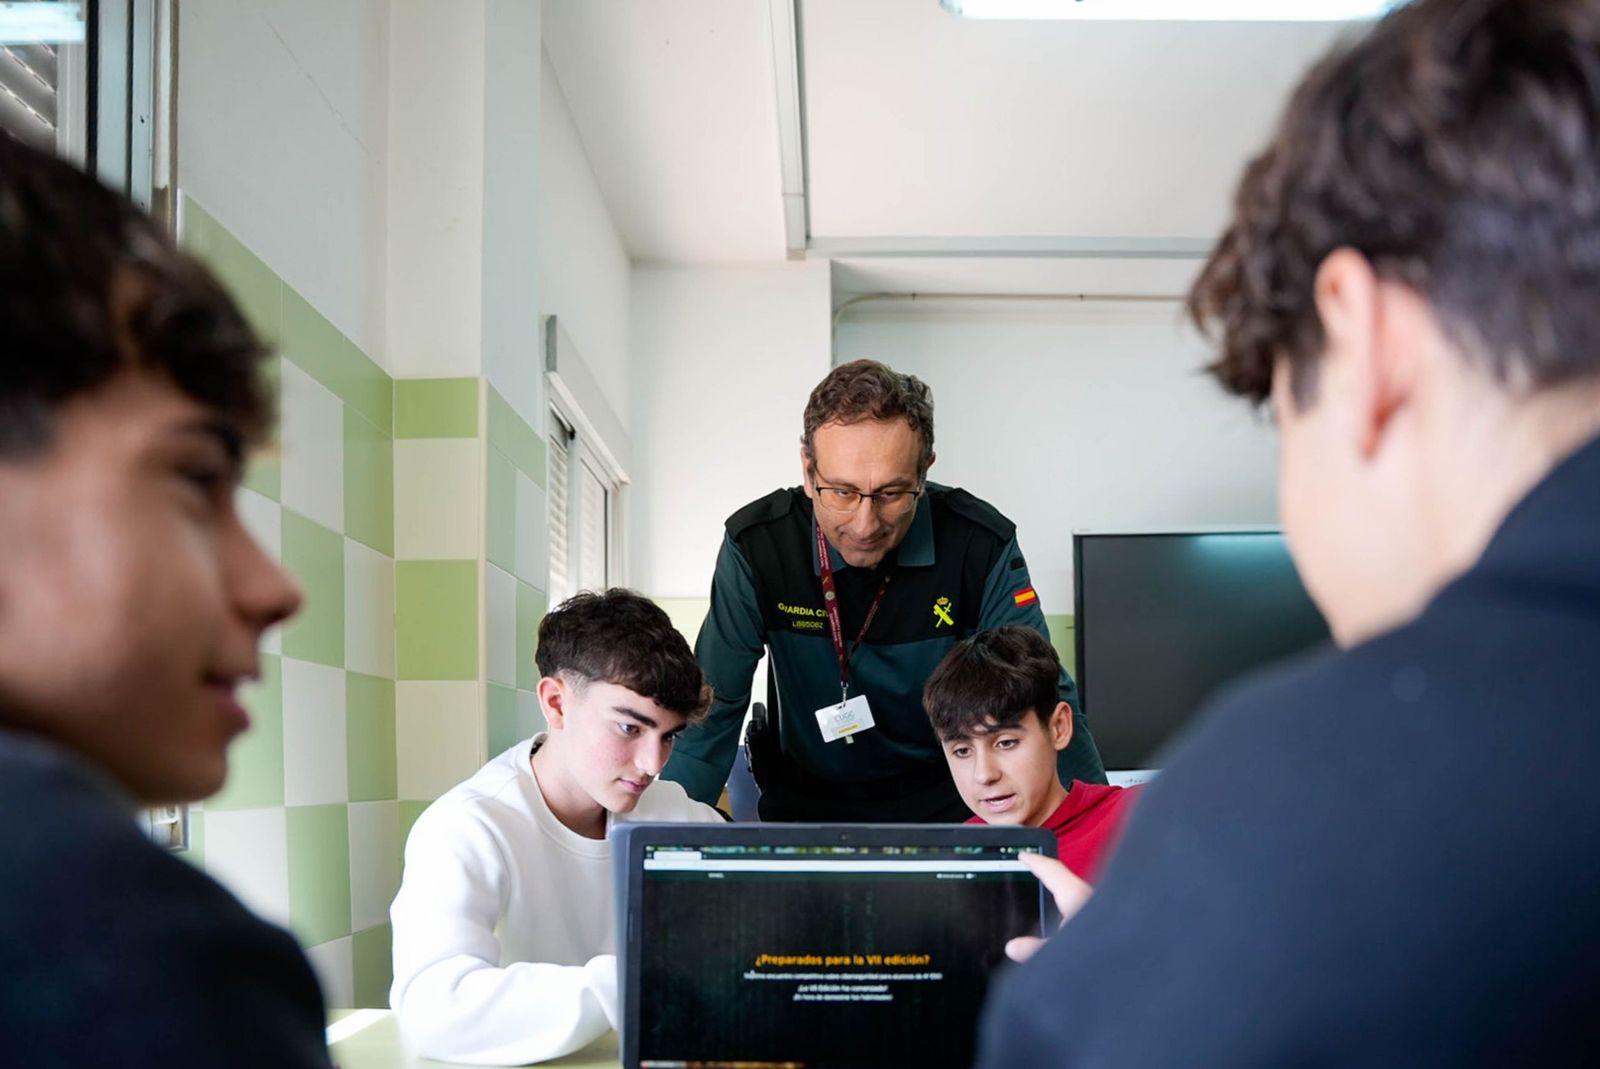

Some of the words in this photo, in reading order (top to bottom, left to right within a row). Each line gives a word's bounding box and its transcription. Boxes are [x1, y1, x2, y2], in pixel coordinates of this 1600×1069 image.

[755, 954, 823, 967] ¿Preparados
[825, 955, 851, 967] para
[853, 954, 865, 966] la
[866, 954, 882, 966] VII
[883, 953, 931, 966] edición?
